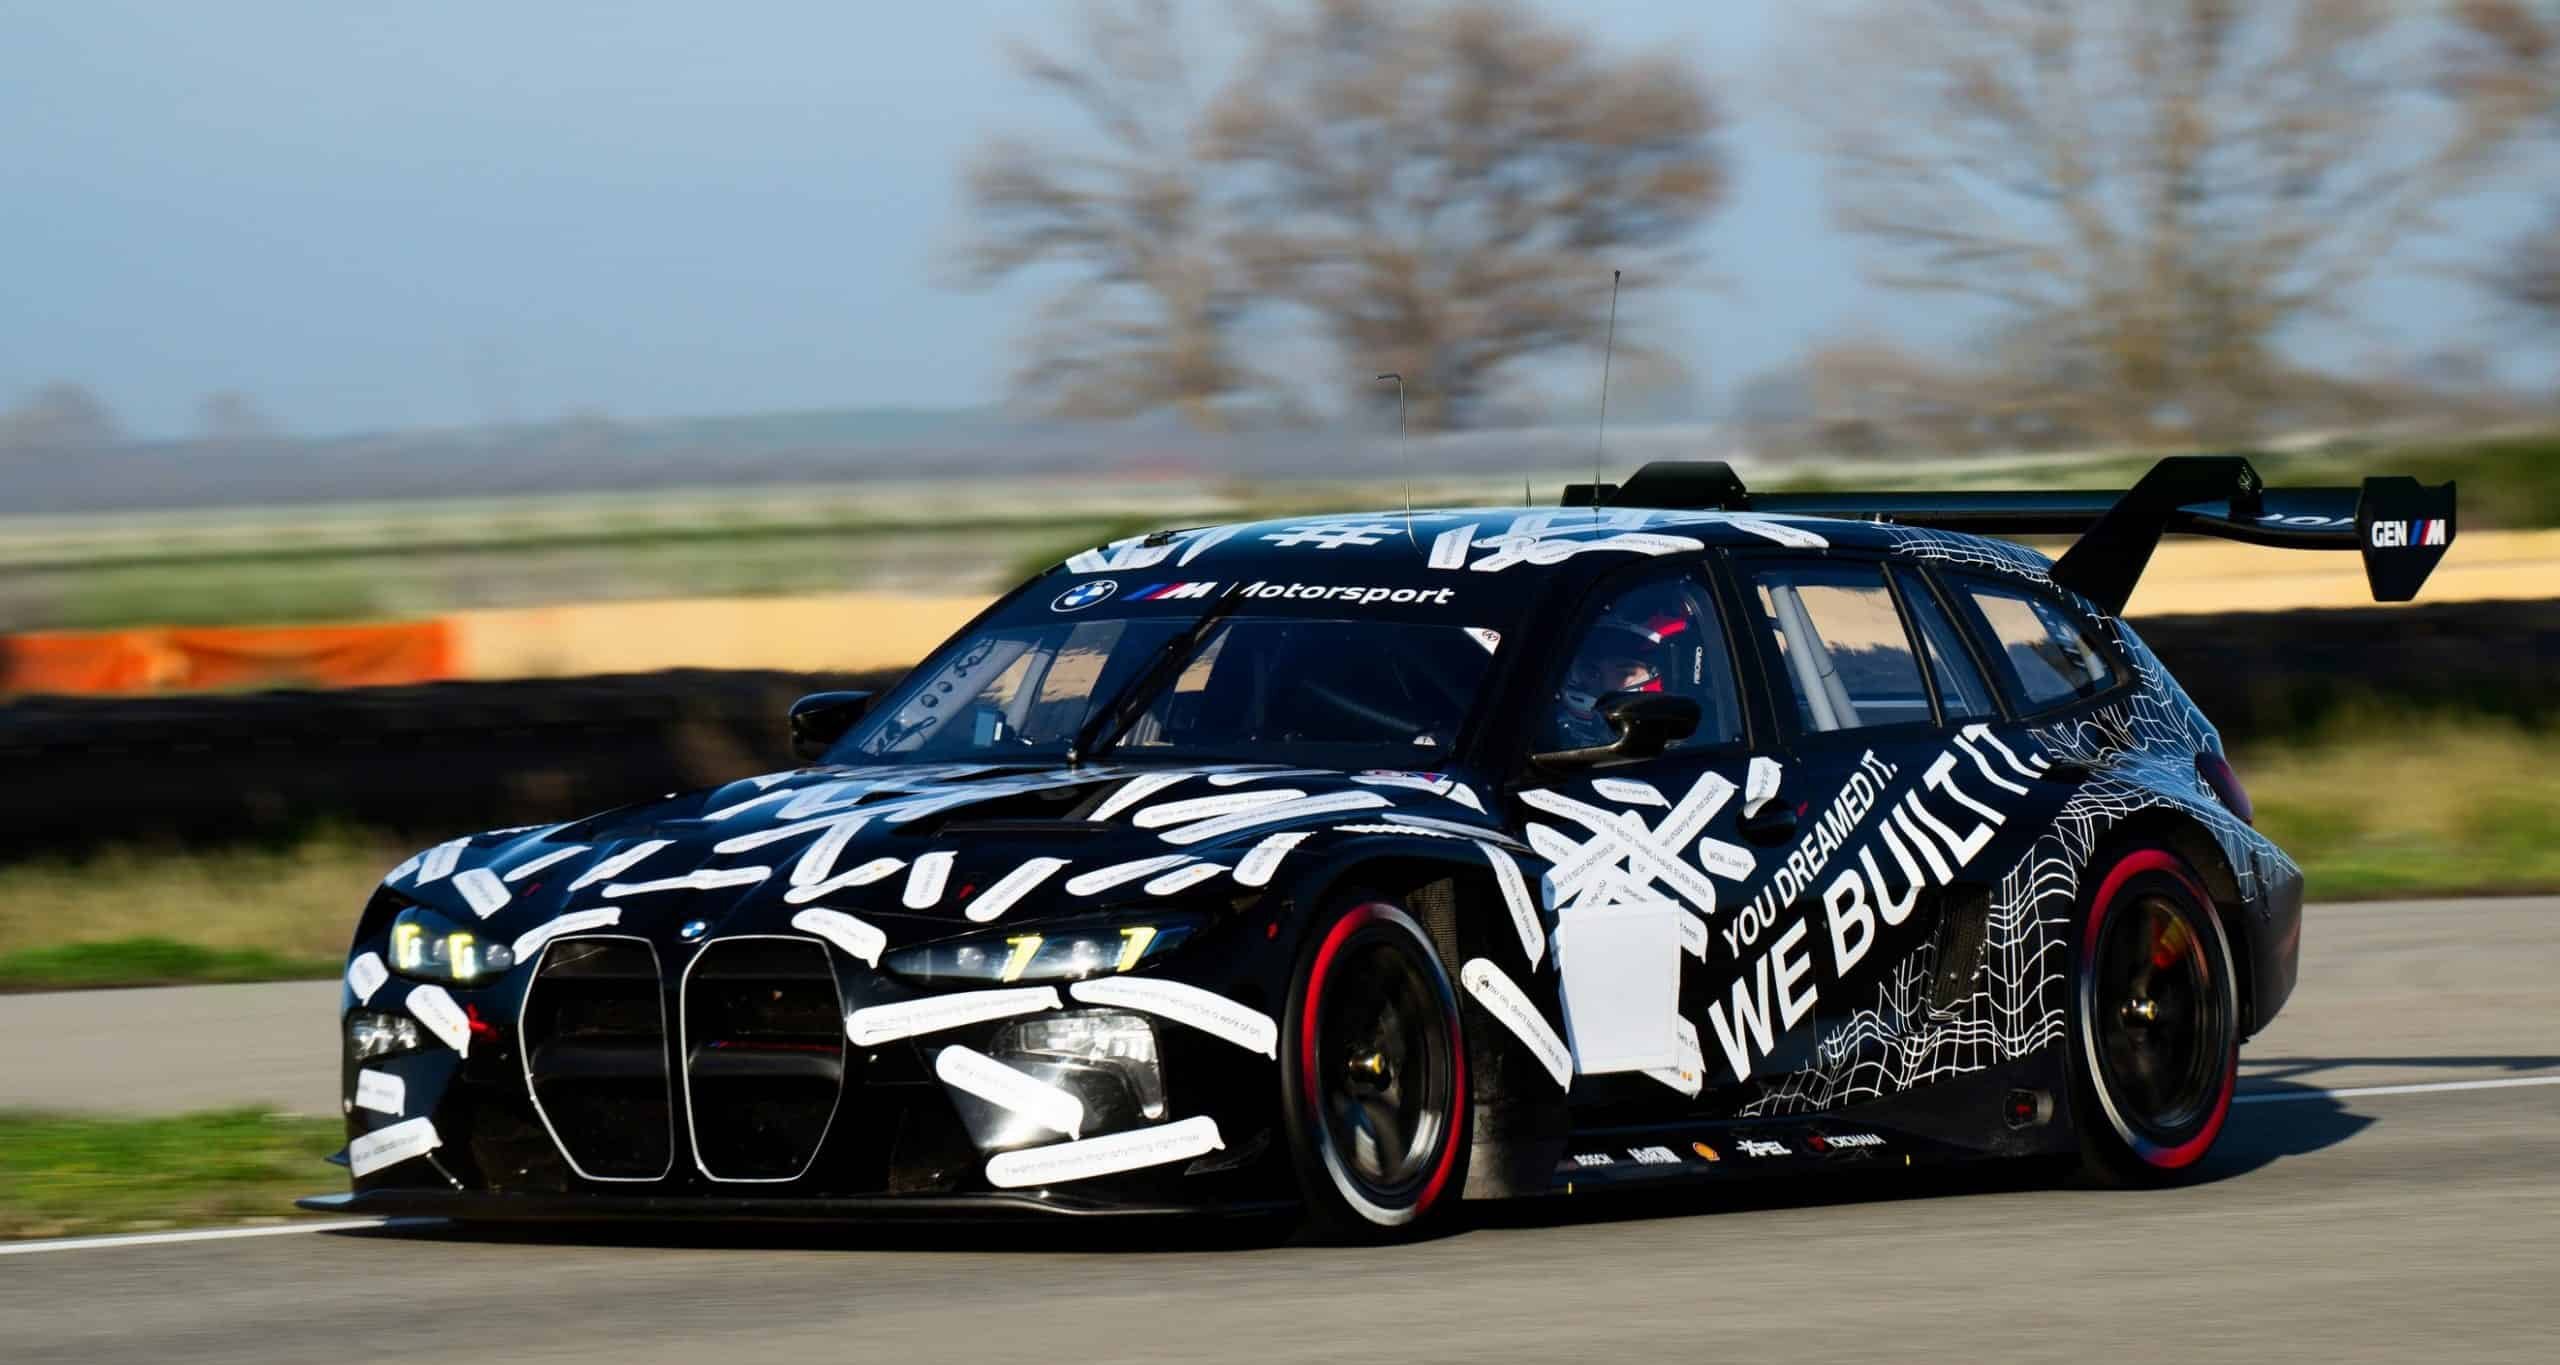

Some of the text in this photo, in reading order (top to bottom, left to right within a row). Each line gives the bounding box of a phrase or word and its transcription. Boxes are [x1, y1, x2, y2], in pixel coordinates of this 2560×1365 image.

[2371, 520, 2408, 548] GEN
[1708, 723, 2051, 1083] WE BUILT IT.
[1722, 749, 1898, 960] YOU DREAMED IT.
